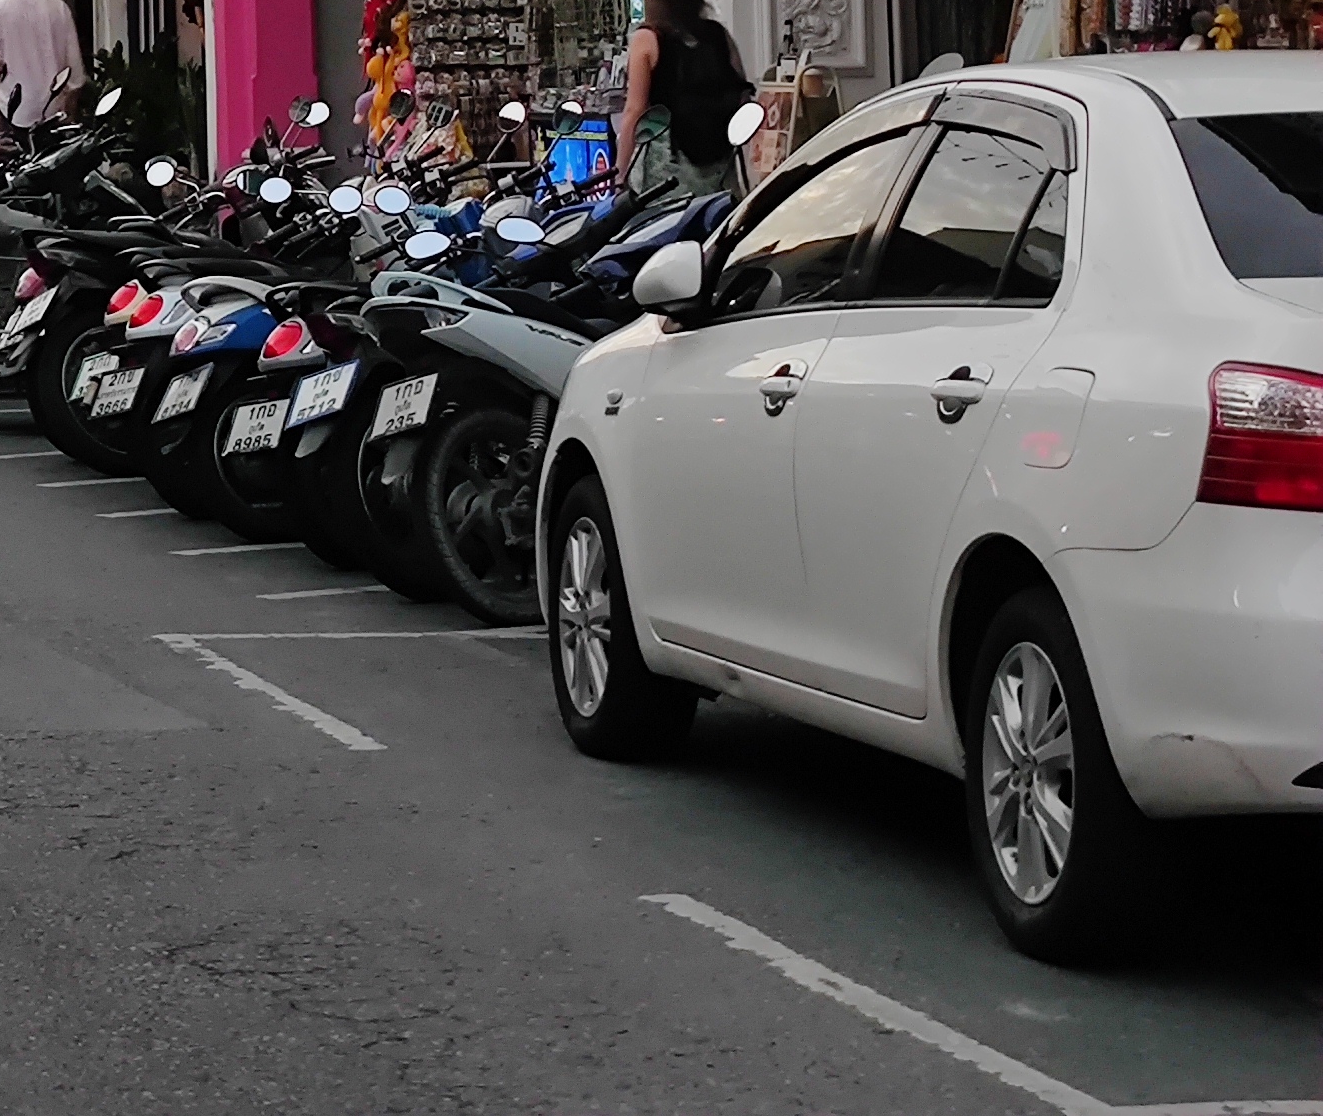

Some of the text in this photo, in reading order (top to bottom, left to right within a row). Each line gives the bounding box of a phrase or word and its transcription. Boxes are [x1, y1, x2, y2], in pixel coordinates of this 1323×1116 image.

[96, 398, 129, 416] 3666
[296, 398, 336, 420] 5712
[385, 412, 416, 432] 235
[233, 433, 273, 450] 8985
